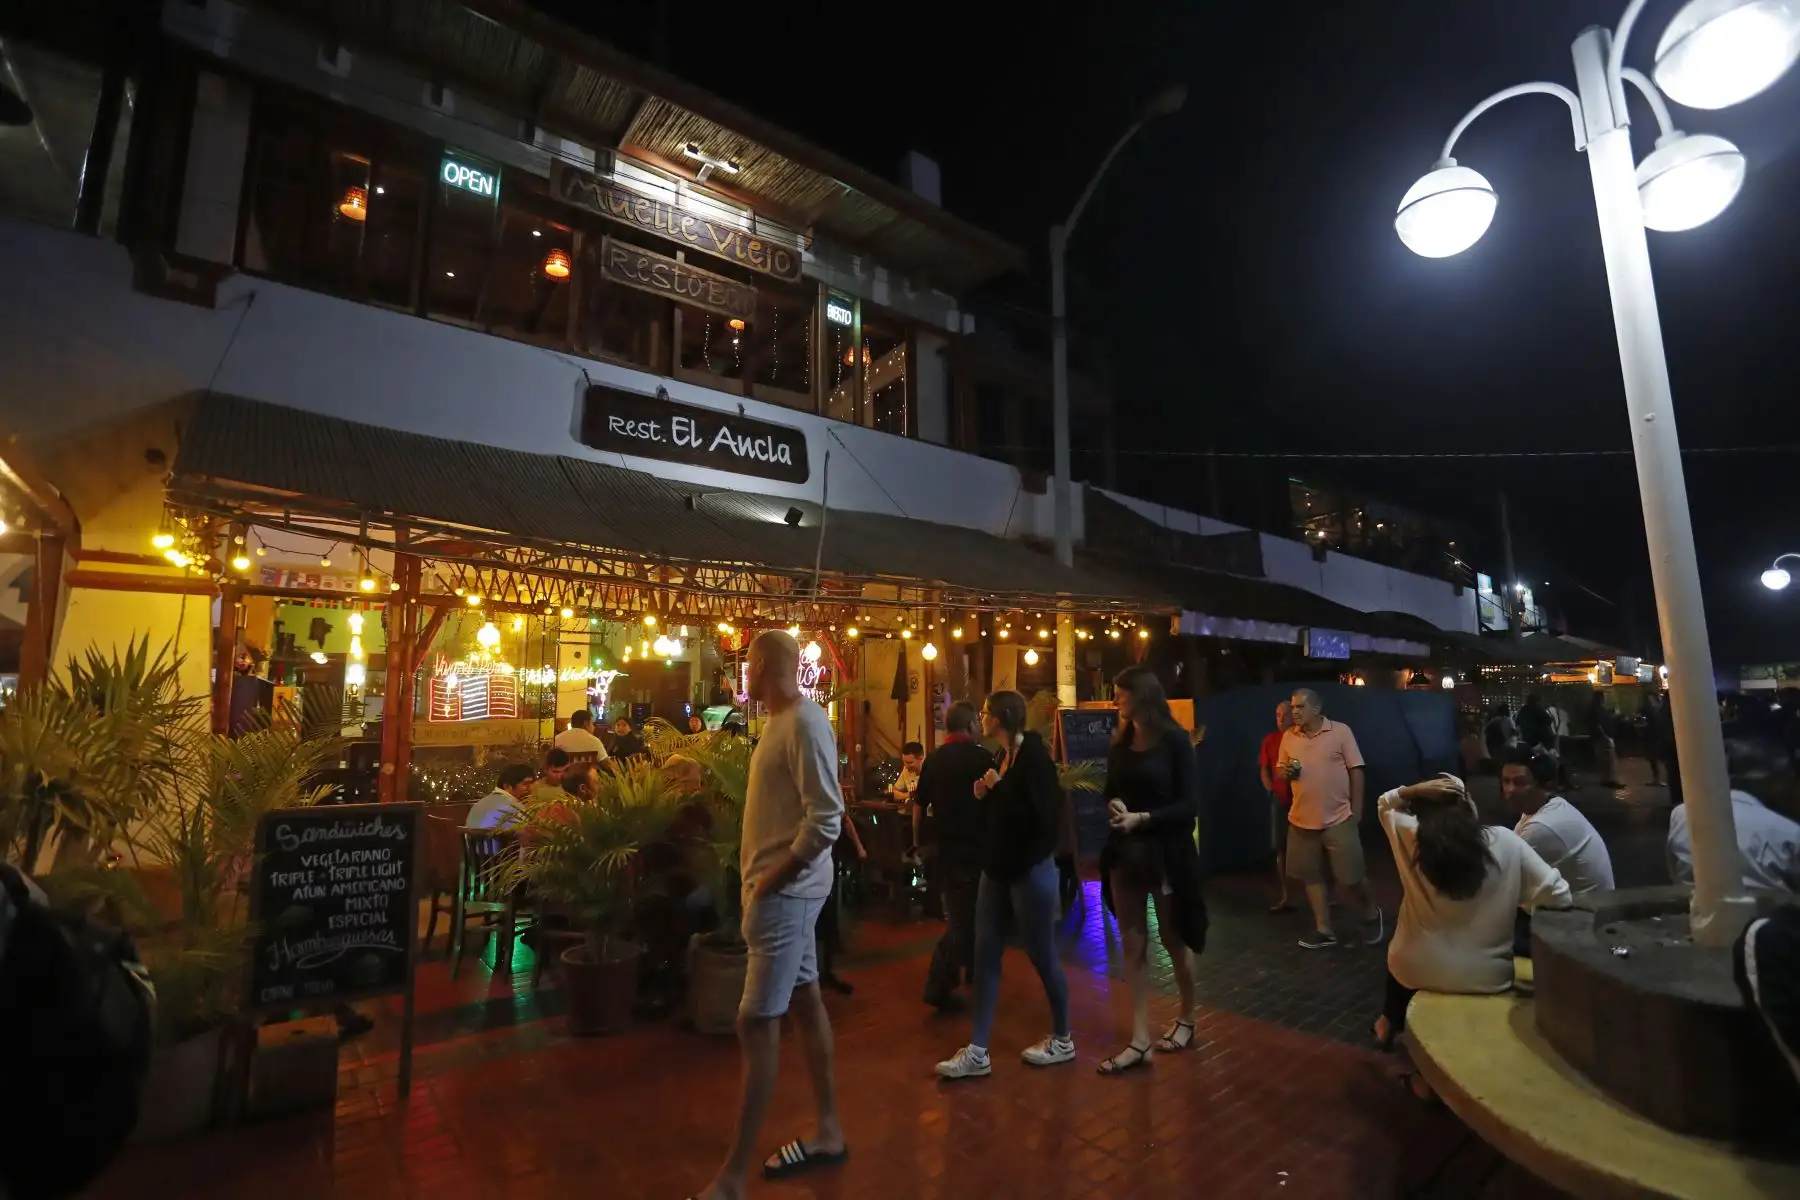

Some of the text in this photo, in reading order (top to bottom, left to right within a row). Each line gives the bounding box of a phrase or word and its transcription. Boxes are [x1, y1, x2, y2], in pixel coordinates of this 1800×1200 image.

[444, 162, 493, 195] OPEN
[563, 175, 791, 274] Muelle Viejo
[608, 415, 793, 466] Rest. El Ancla
[300, 848, 391, 868] VEGETARIANO
[269, 860, 404, 888] TRIPLE TRIPLE LIGHT
[292, 878, 406, 901] ATUN AMERICANO
[344, 894, 390, 912] MIXTO
[327, 912, 389, 930] ESPECIAL
[267, 929, 400, 971] Hambguesas
